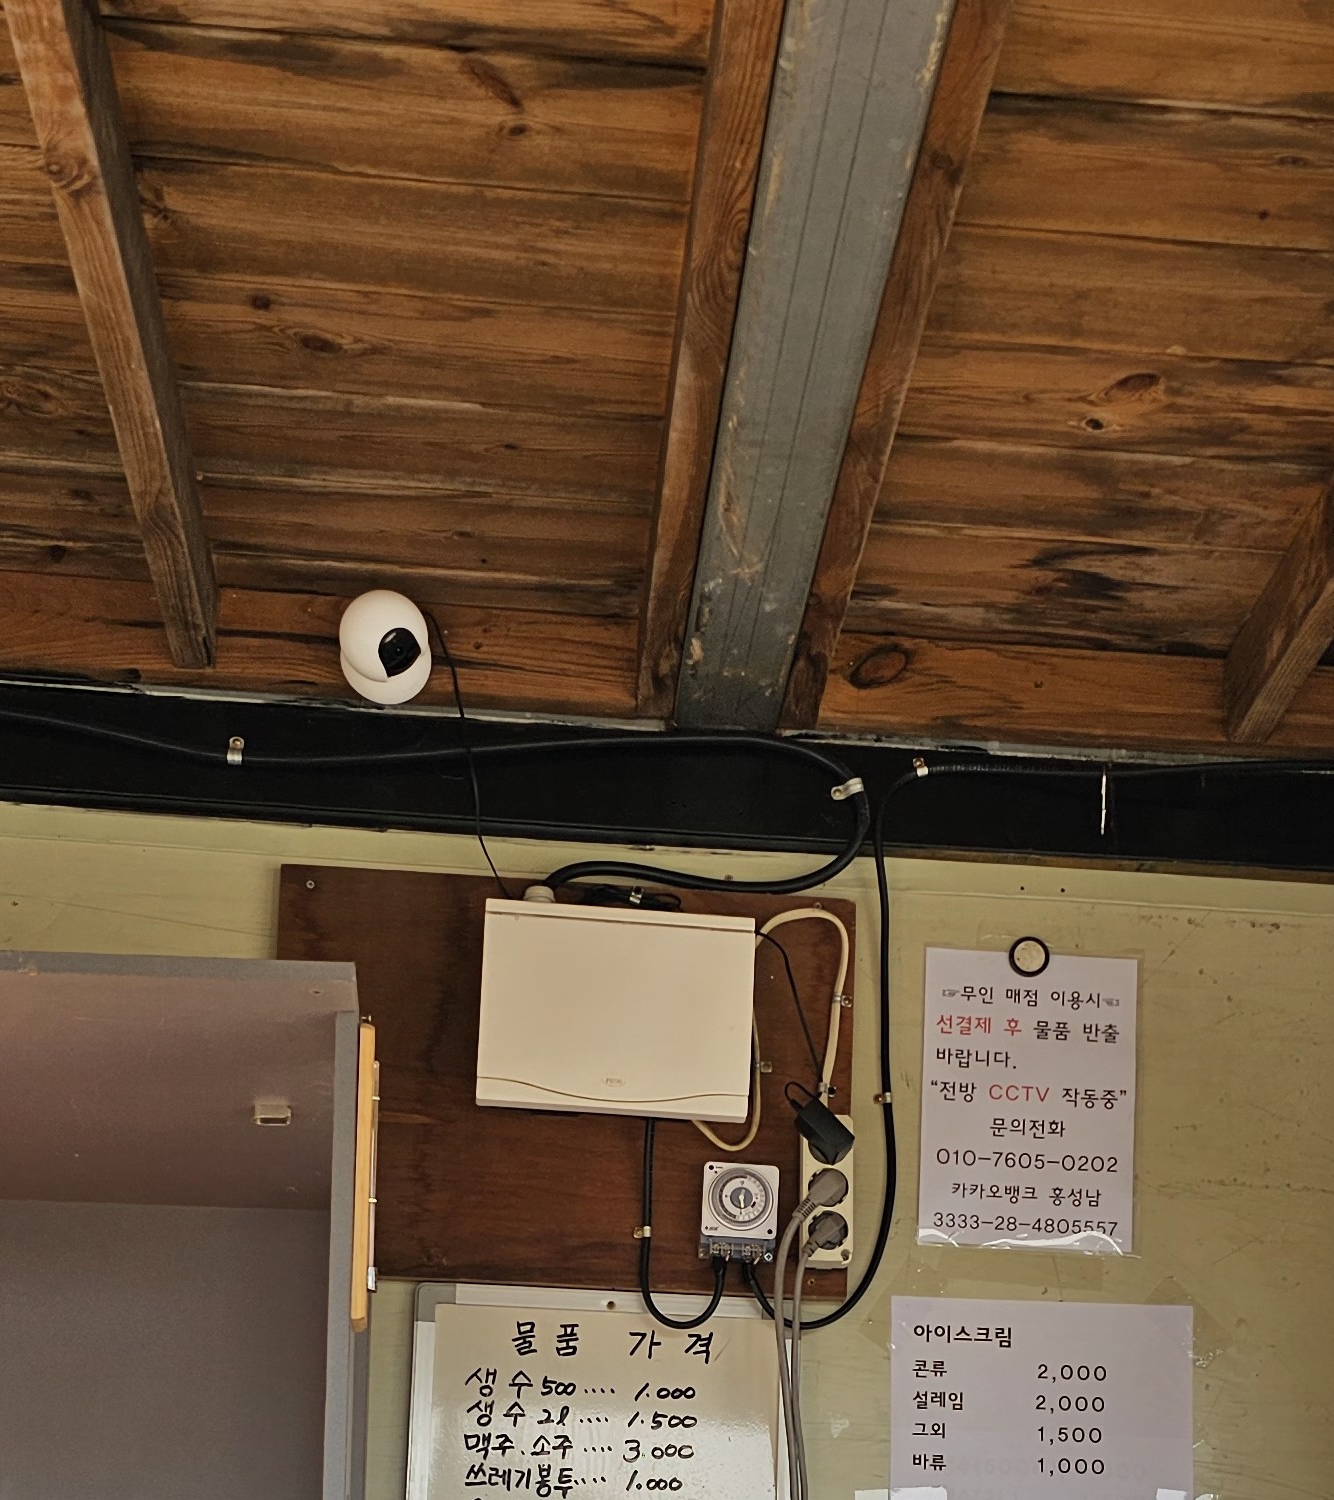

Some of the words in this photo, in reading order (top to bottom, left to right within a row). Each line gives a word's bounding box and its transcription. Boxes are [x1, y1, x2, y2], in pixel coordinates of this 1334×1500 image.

[960, 986, 994, 1005] 무인
[1005, 988, 1039, 1007] 매점
[1050, 990, 1102, 1010] 이용시
[936, 1015, 991, 1036] 선결제
[1004, 1017, 1022, 1036] 후
[1033, 1020, 1071, 1041] 물품
[1083, 1023, 1120, 1044] 반출
[936, 1048, 1017, 1069] 바랍니다.
[988, 1084, 1050, 1102] CCTV
[990, 1117, 1066, 1139] 문의전화
[936, 1148, 1118, 1173] 010-7605-0202
[951, 1182, 1038, 1205] 카카오뱅크
[1049, 1186, 1102, 1208] 홍성남
[933, 1212, 1118, 1237] 3333-28-4805557
[913, 1324, 1013, 1349] 아이스크림
[912, 1359, 948, 1378] 콘류
[1037, 1363, 1108, 1382] 2,000
[912, 1391, 964, 1411] 설레임
[1035, 1395, 1105, 1414] 2,000
[912, 1422, 946, 1440] 그외
[1037, 1425, 1103, 1445] 1,500
[912, 1453, 947, 1472] 바류
[1037, 1457, 1105, 1476] 1,000
